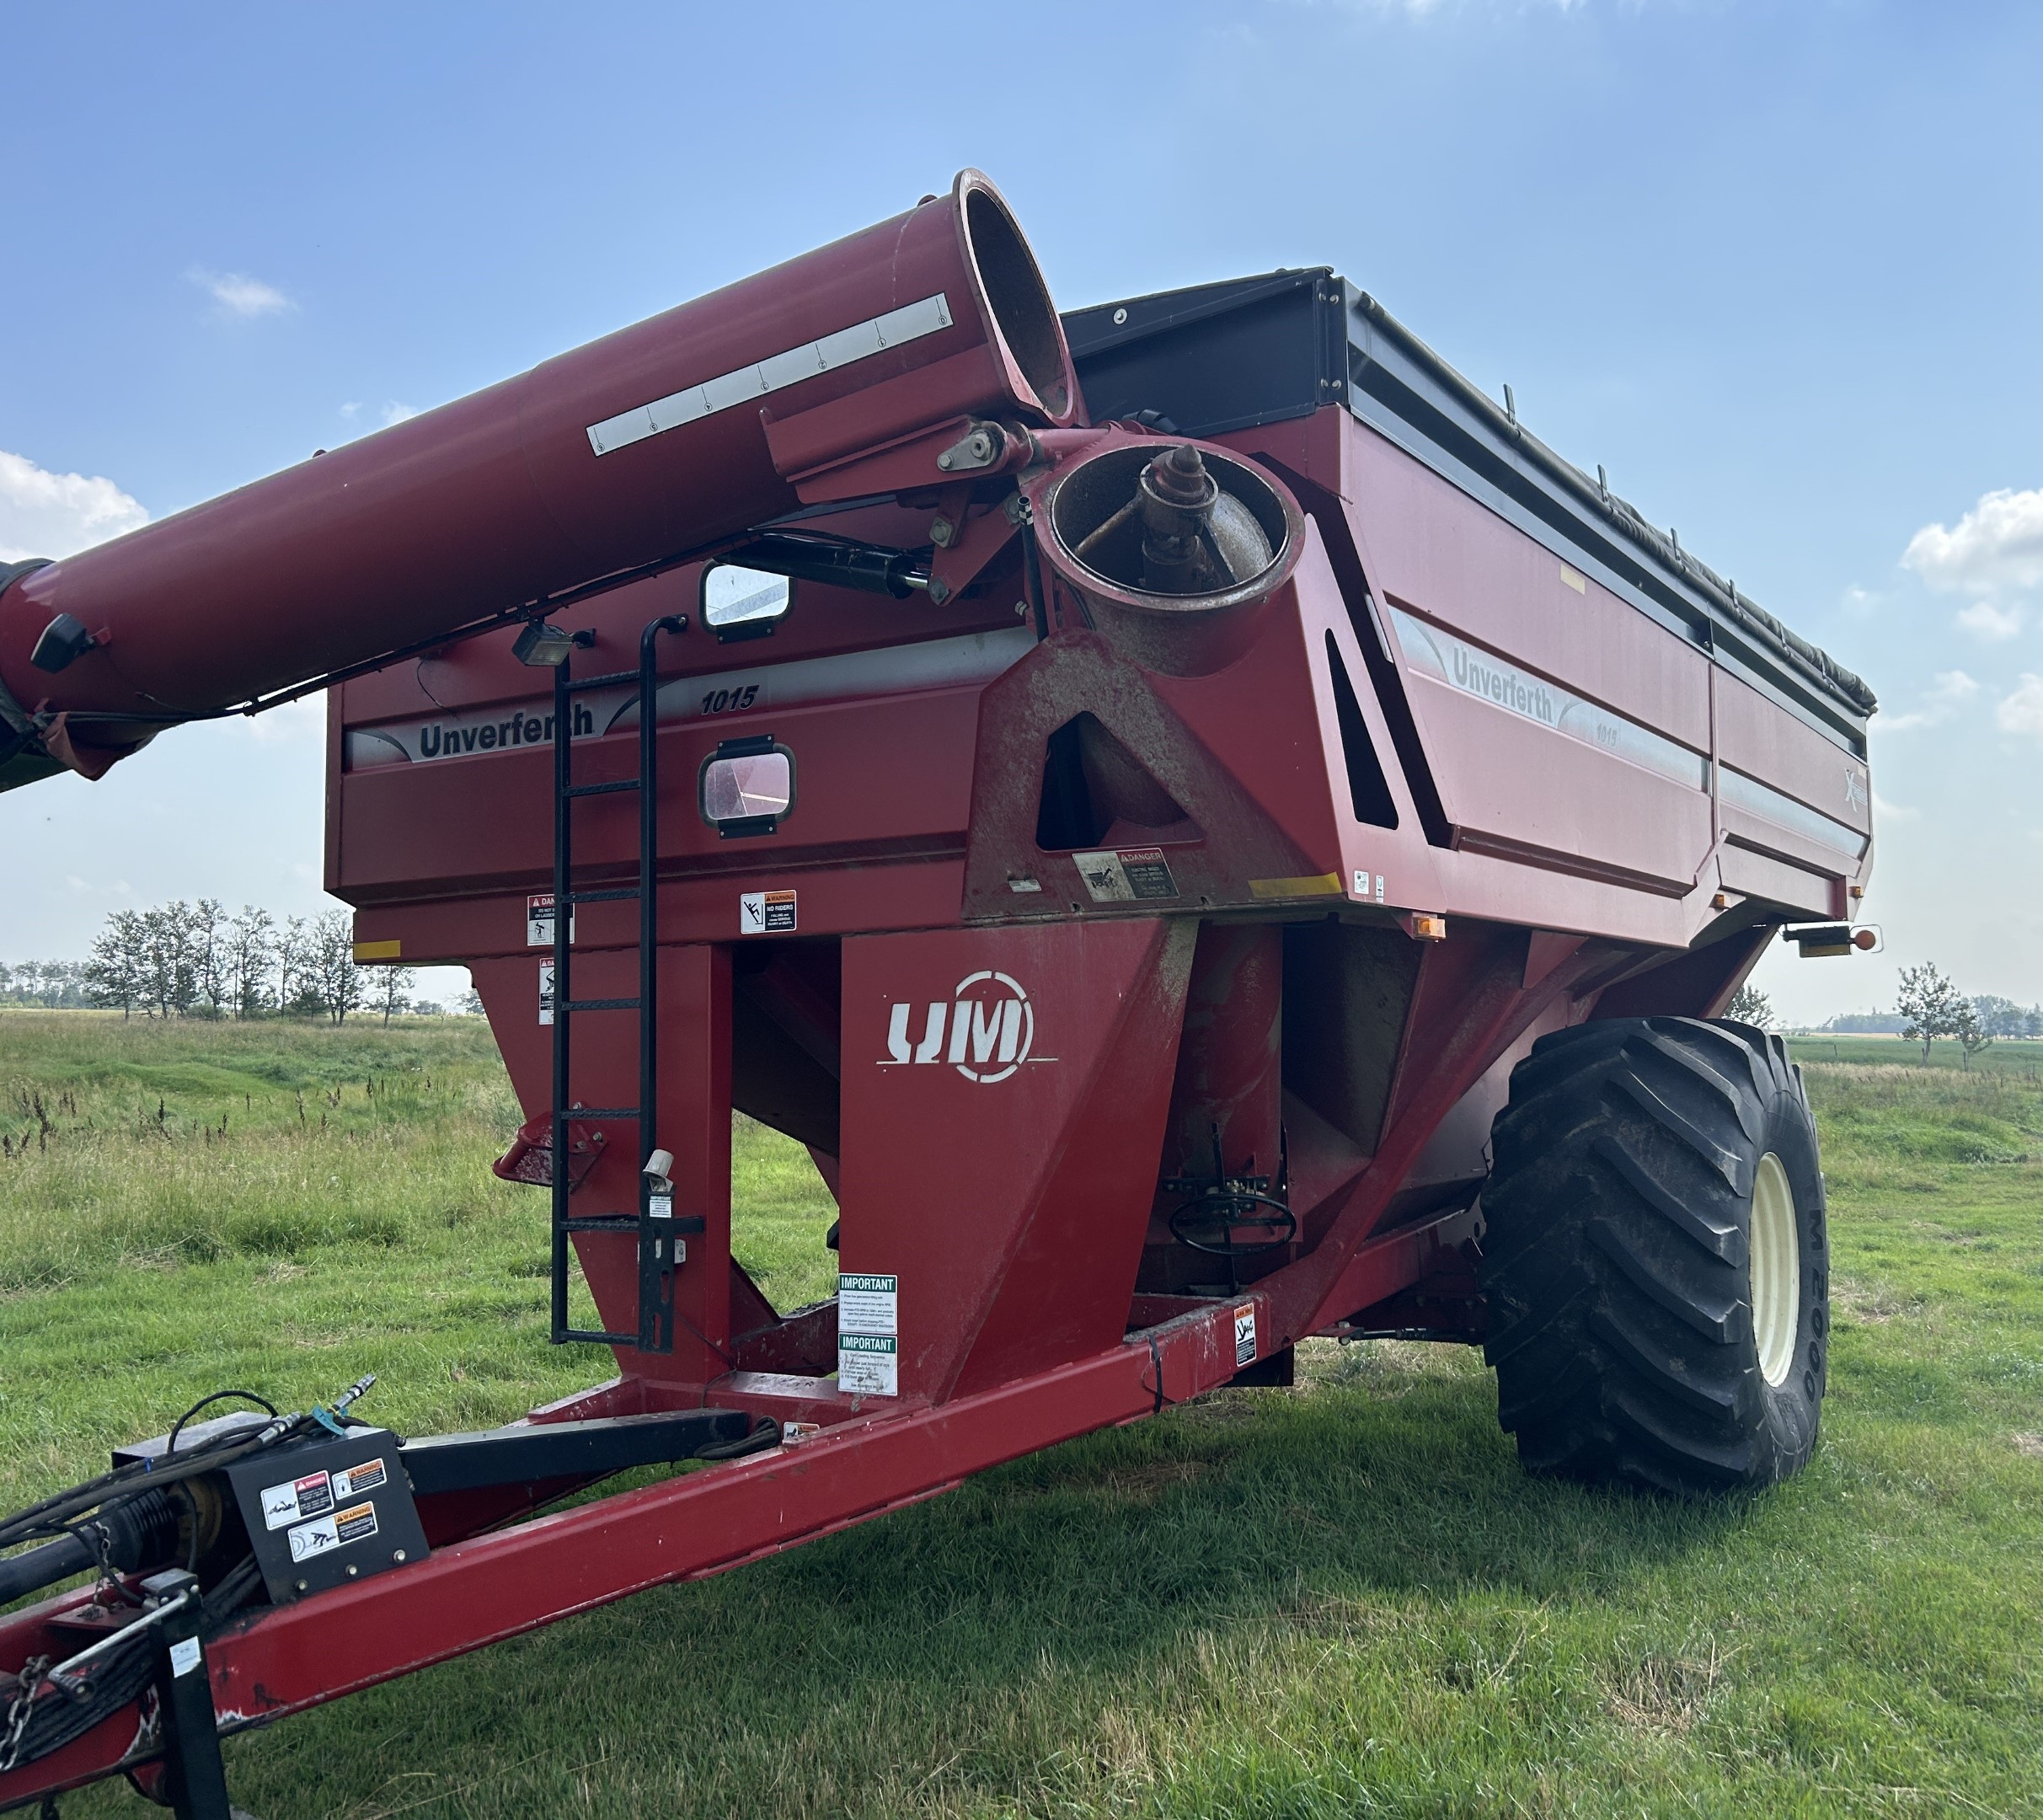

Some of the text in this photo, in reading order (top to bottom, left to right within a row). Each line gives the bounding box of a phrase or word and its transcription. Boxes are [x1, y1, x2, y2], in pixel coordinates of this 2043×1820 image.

[1453, 647, 1553, 724] Unverferth
[701, 684, 760, 715] 1015
[421, 703, 593, 757] Unverferh
[1596, 722, 1618, 747] 1015
[1127, 852, 1162, 861] DANGER
[542, 897, 555, 906] DAN
[841, 1277, 894, 1291] IMPORTANT
[1804, 1267, 1824, 1405] 2000
[842, 1336, 892, 1351] IMPORTANT
[356, 1462, 380, 1475] WARNING
[305, 1476, 326, 1487] DANGER
[343, 1506, 371, 1520] WARNING
